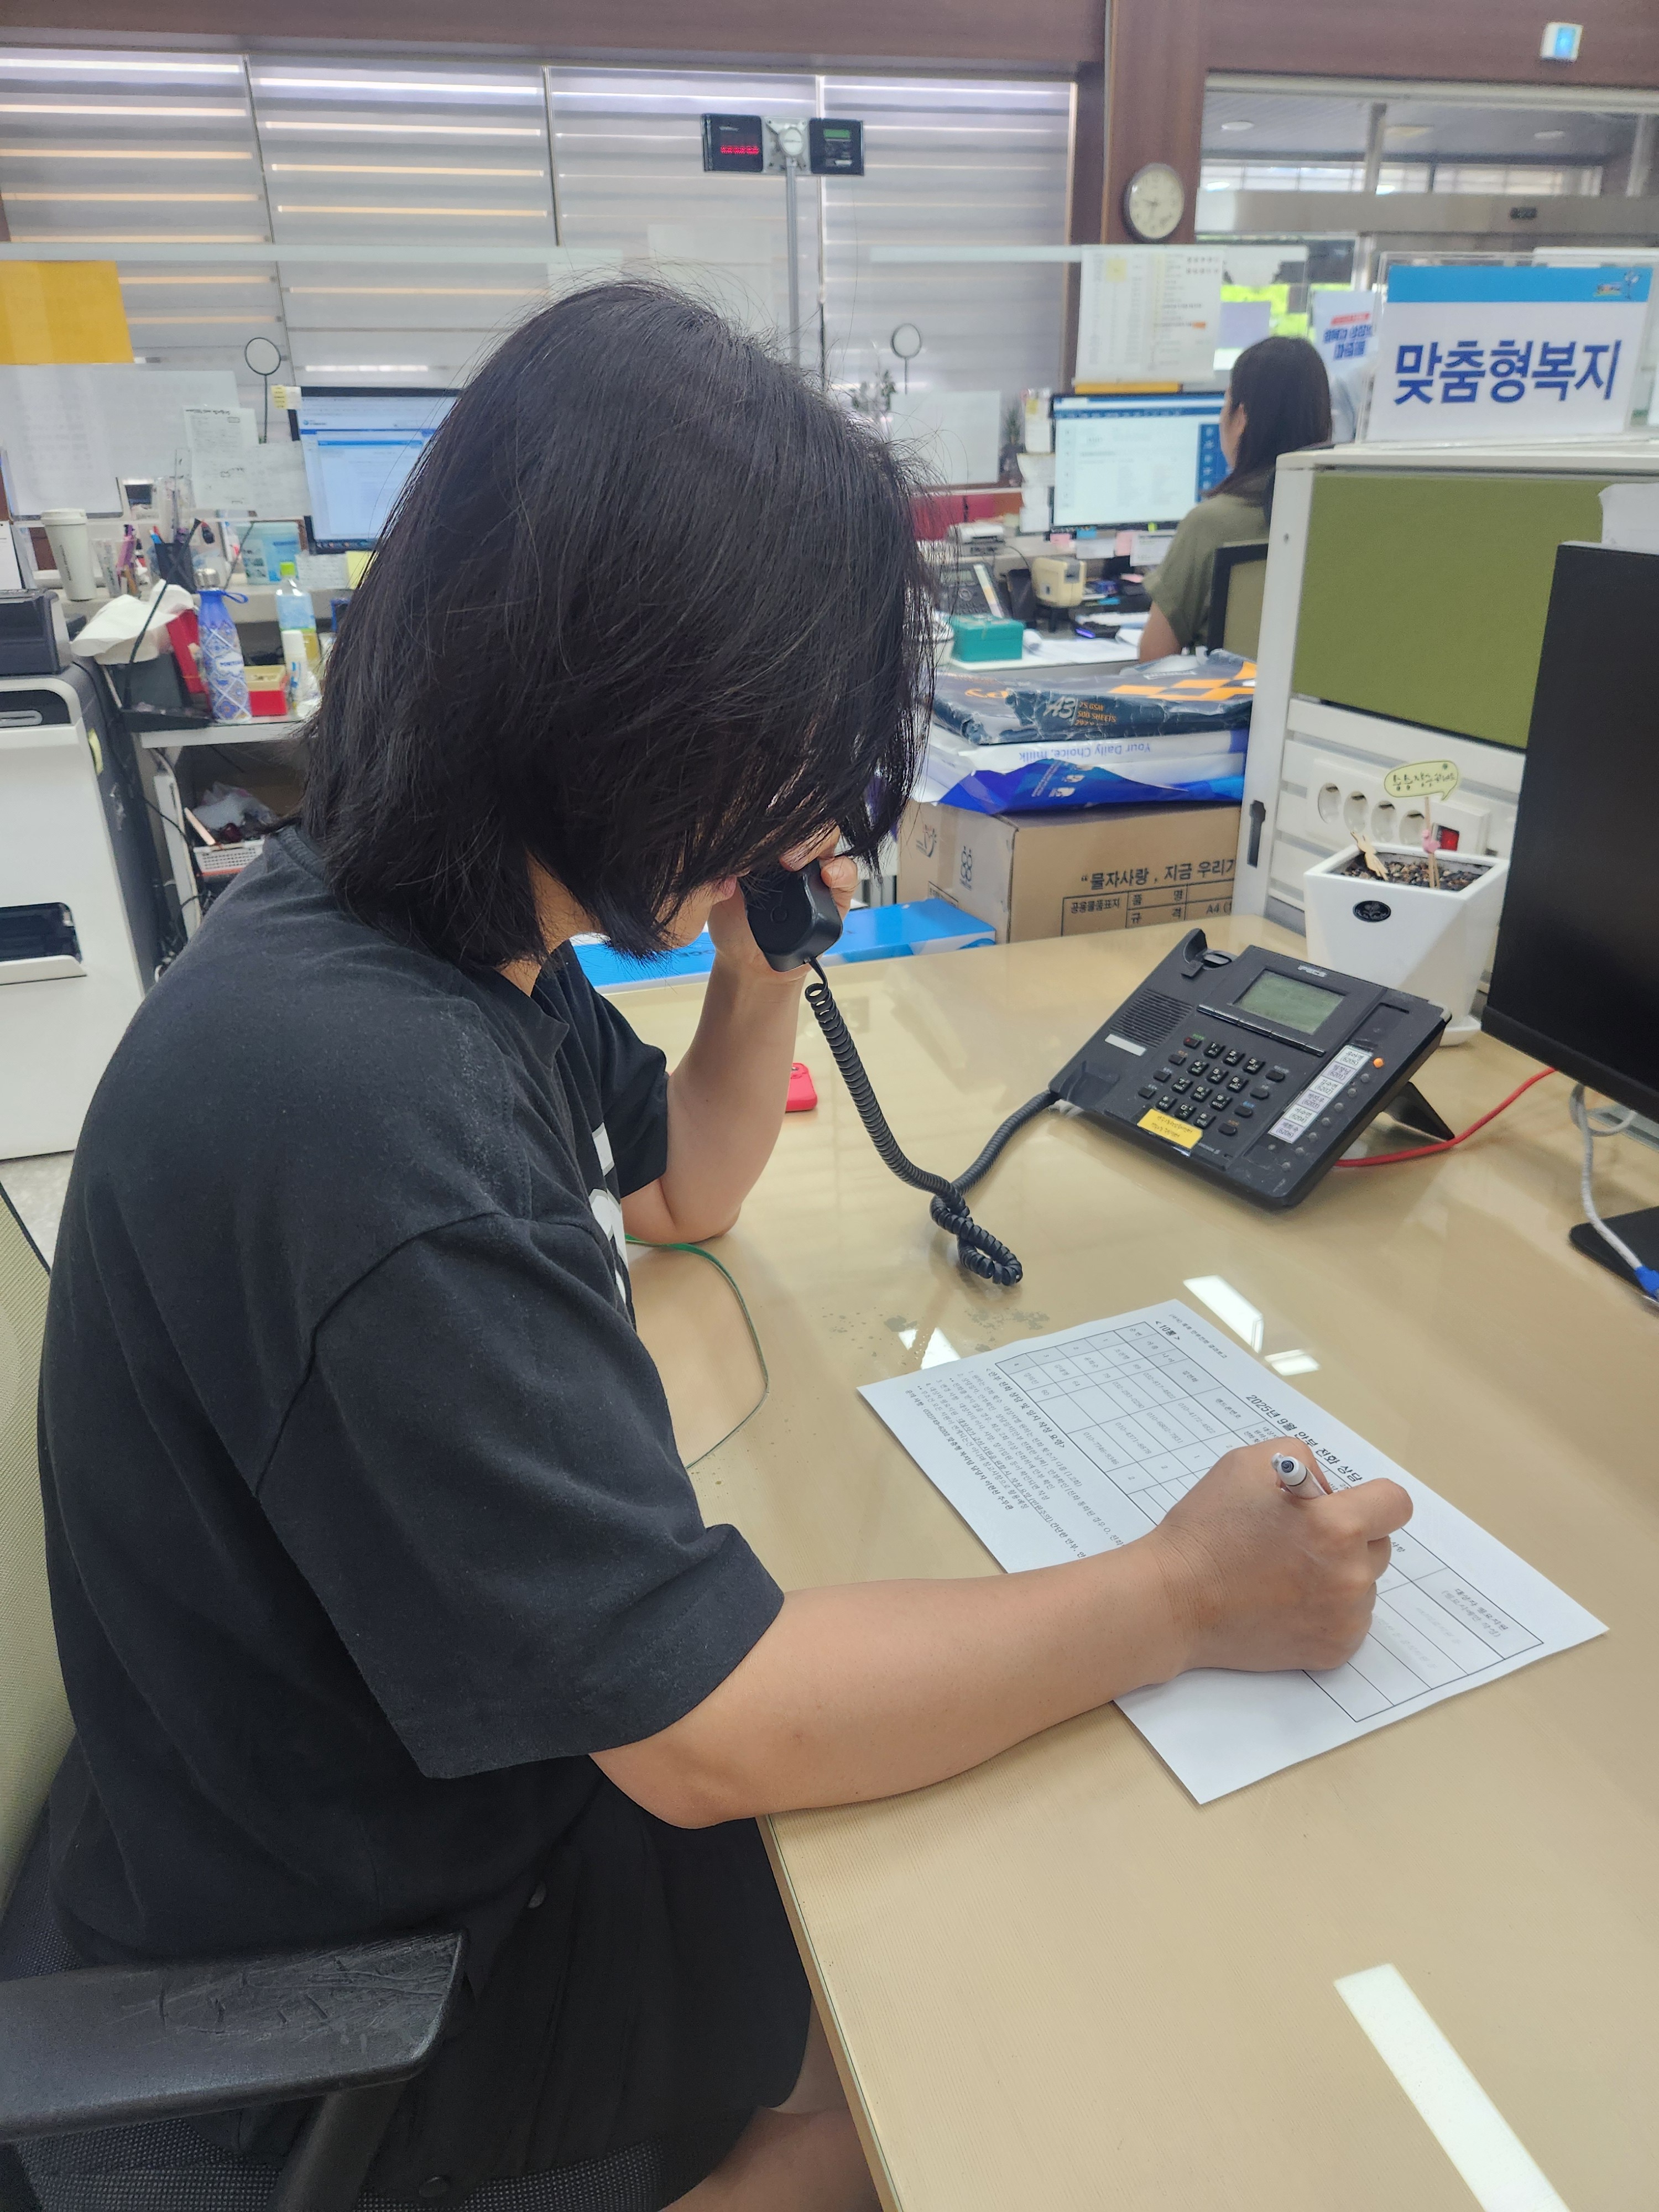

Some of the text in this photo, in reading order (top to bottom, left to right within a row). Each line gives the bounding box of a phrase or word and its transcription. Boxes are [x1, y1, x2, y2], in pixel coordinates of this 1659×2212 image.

[1394, 338, 1621, 405] 맞춤형복지
[1043, 696, 1076, 718] A3
[1095, 744, 1122, 755] Daily
[1126, 743, 1151, 753] Your
[1164, 863, 1192, 881] 지금
[997, 1381, 1013, 1391] 전화
[1006, 1391, 1024, 1402] 상담
[1024, 1409, 1041, 1421] 일지
[1035, 1421, 1053, 1433] 작성
[1018, 1423, 1036, 1437] 원하는
[1031, 1437, 1045, 1447] 전화
[1245, 1394, 1364, 1483] 2025년 9월 안부 전화 상담
[969, 1465, 988, 1480] 담당자
[1005, 1440, 1019, 1450] 이상
[1031, 1468, 1046, 1479] 안부
[1041, 1479, 1056, 1489] 확인
[1009, 1460, 1023, 1470] 등이
[1018, 1470, 1041, 1490] 확인되면
[1035, 1489, 1051, 1500] 작성
[1091, 1516, 1107, 1528] 경우
